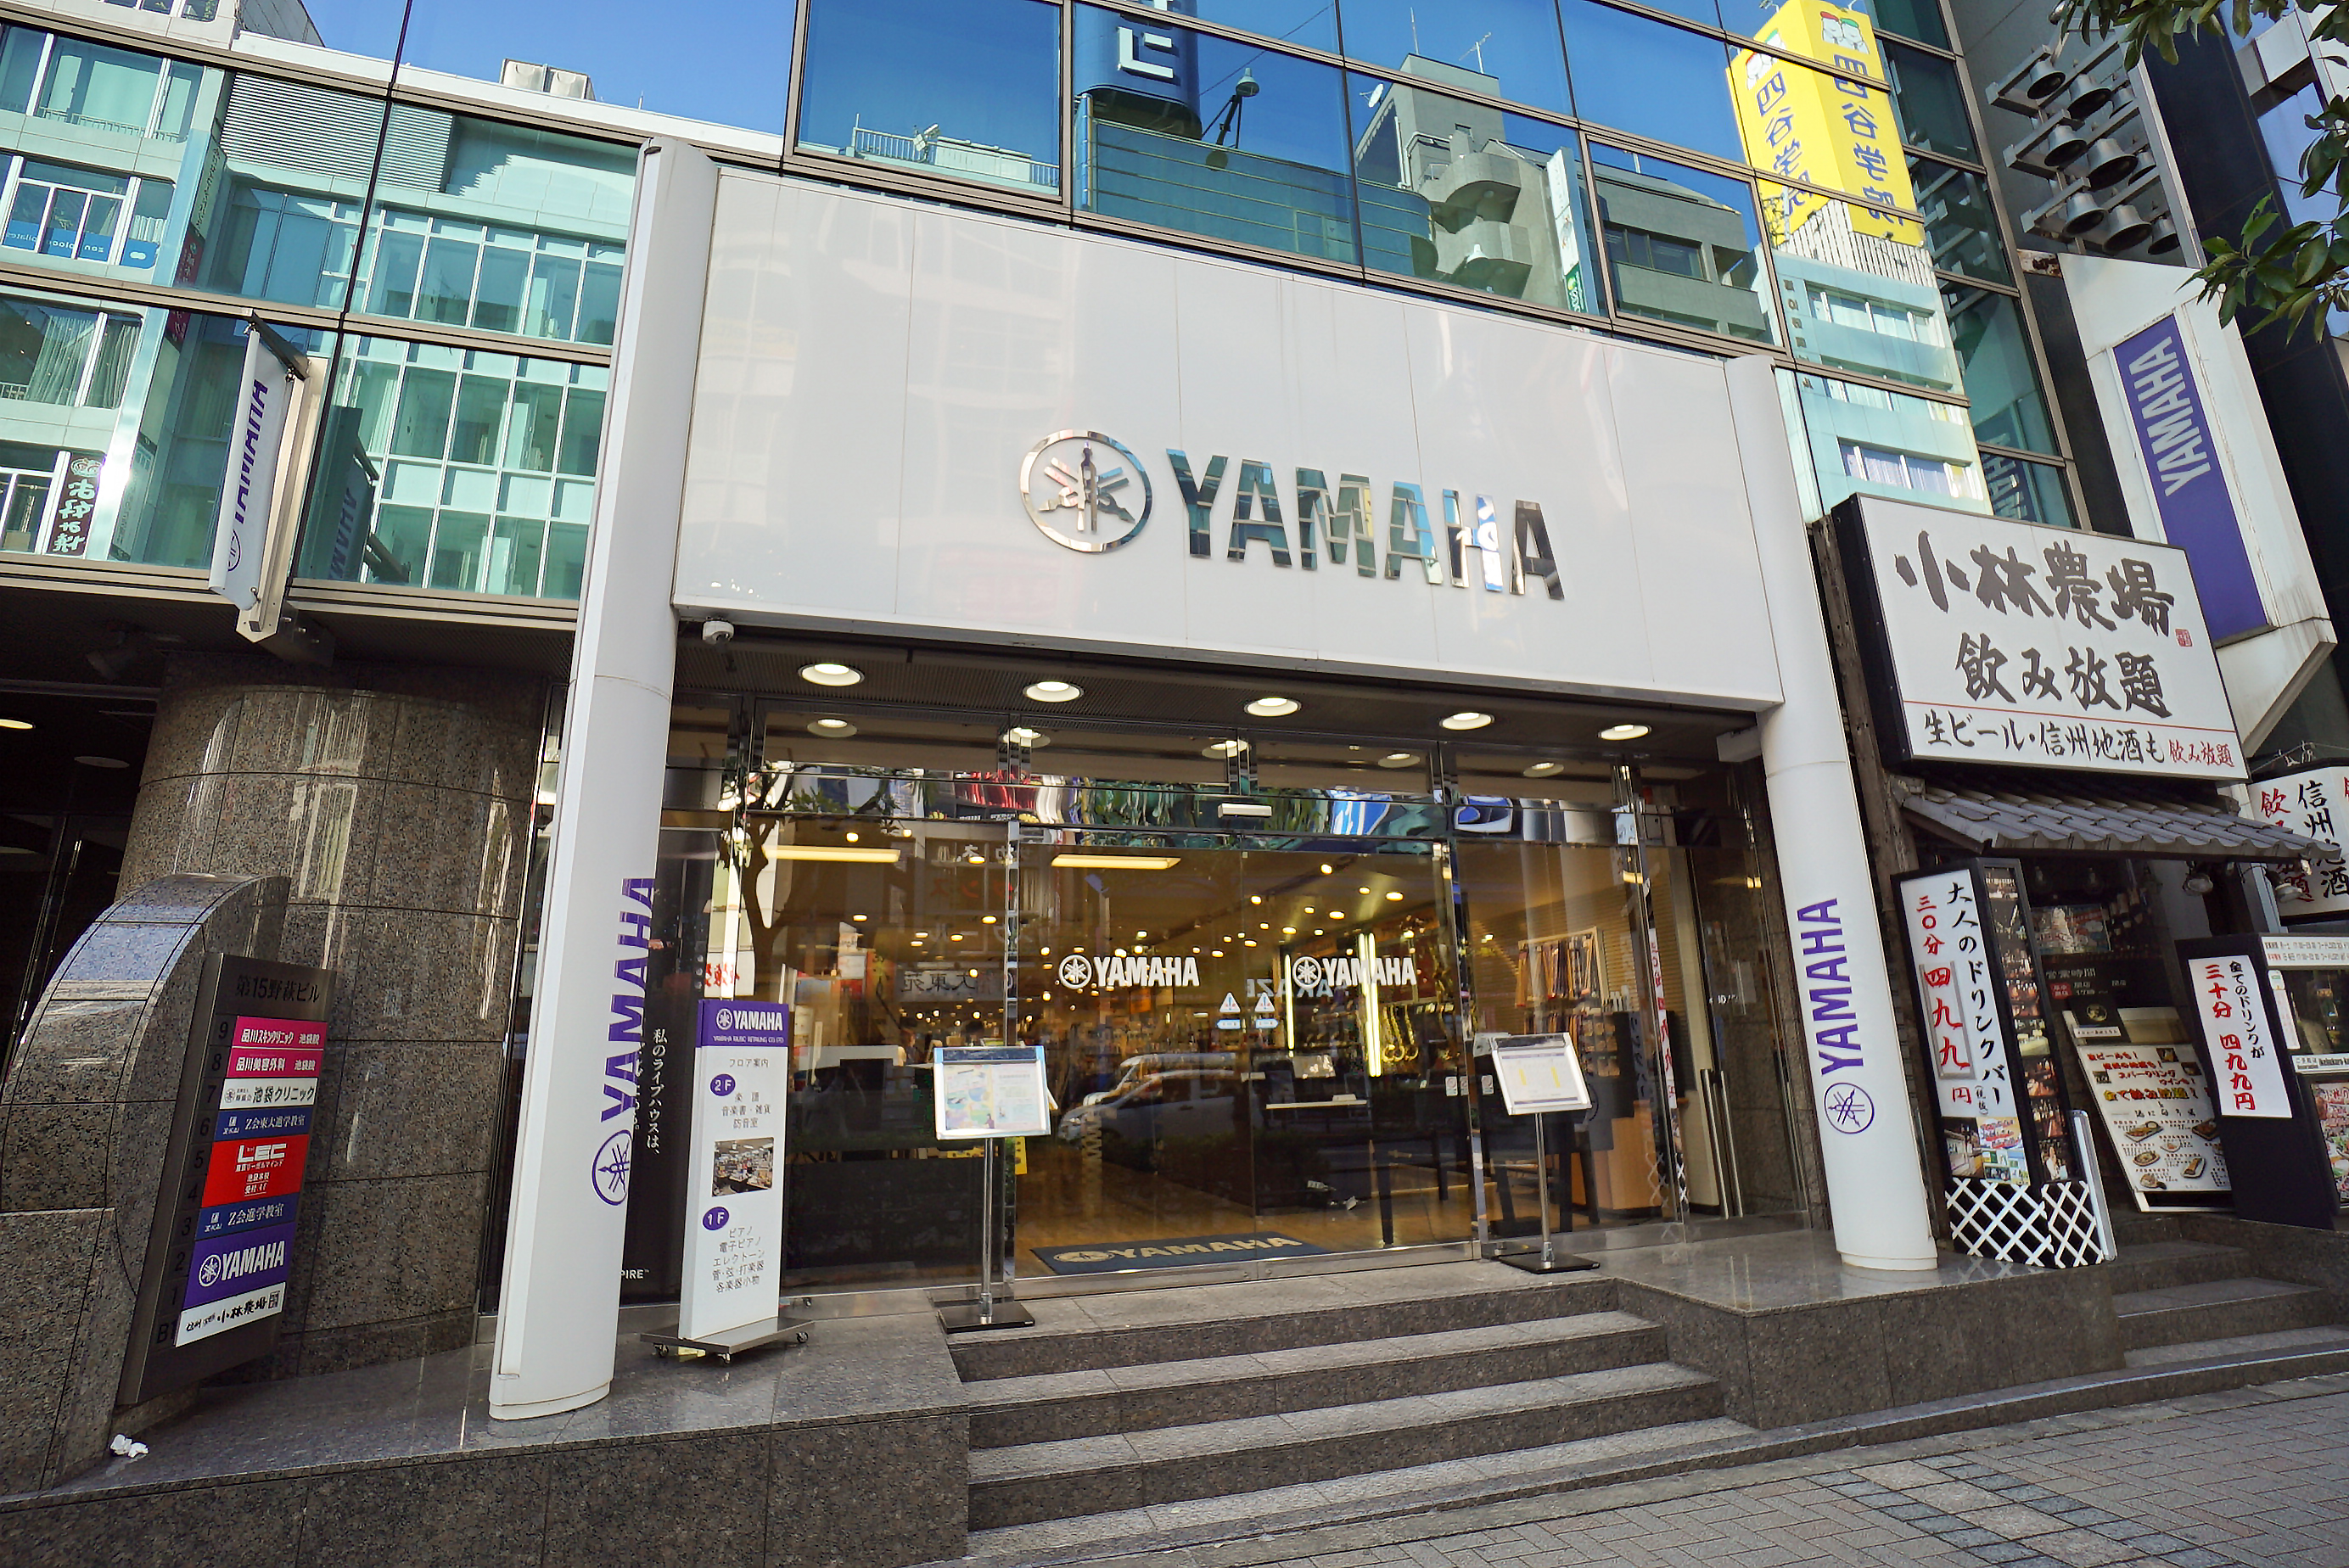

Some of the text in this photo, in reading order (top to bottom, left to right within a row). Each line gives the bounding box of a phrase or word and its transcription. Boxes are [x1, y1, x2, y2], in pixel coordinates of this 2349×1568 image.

[2128, 336, 2212, 496] YAMAHA
[1166, 448, 1566, 601] YAMAHA
[1894, 529, 2176, 639] 小林農場
[1954, 631, 2172, 720] 飲み放題
[1923, 709, 2234, 769] 生ビール・信州地酒も 飲み放題
[1094, 956, 1200, 987] YAMAHA
[1322, 957, 1417, 987] YAMAHA
[1796, 897, 1866, 1076] YAMAHA
[1946, 882, 2005, 1106] 大人のドリンクバー
[599, 877, 655, 1123] YAMAHA
[733, 1010, 783, 1031] YAMAHA
[218, 1022, 228, 1040] 9
[241, 1028, 320, 1045] 品川スキンクリニック 池袋院
[211, 1053, 222, 1072] 8
[236, 1057, 285, 1071] 品川美容外科
[729, 1058, 769, 1068] フロア案内
[208, 1084, 217, 1102] 7
[253, 1086, 315, 1103] 池袋クリニック
[649, 1028, 669, 1155] 私のライブハウスは、
[714, 1079, 732, 1092] 2F
[199, 1117, 210, 1136] 6
[244, 1114, 306, 1130] Z会東大進学教室
[193, 1150, 205, 1169] 5
[238, 1144, 287, 1162] LEC
[188, 1184, 198, 1201] 4
[227, 1203, 284, 1225] Z会進学教室
[707, 1212, 725, 1227] 1F
[181, 1217, 192, 1232] 3
[729, 1226, 753, 1239] ピアノ
[719, 1236, 761, 1253] 電子ピアノ
[1108, 1236, 1303, 1259] YAMAHA
[174, 1252, 186, 1271] 2
[221, 1240, 285, 1281] YAMAHA
[713, 1249, 765, 1267] エレクトーン
